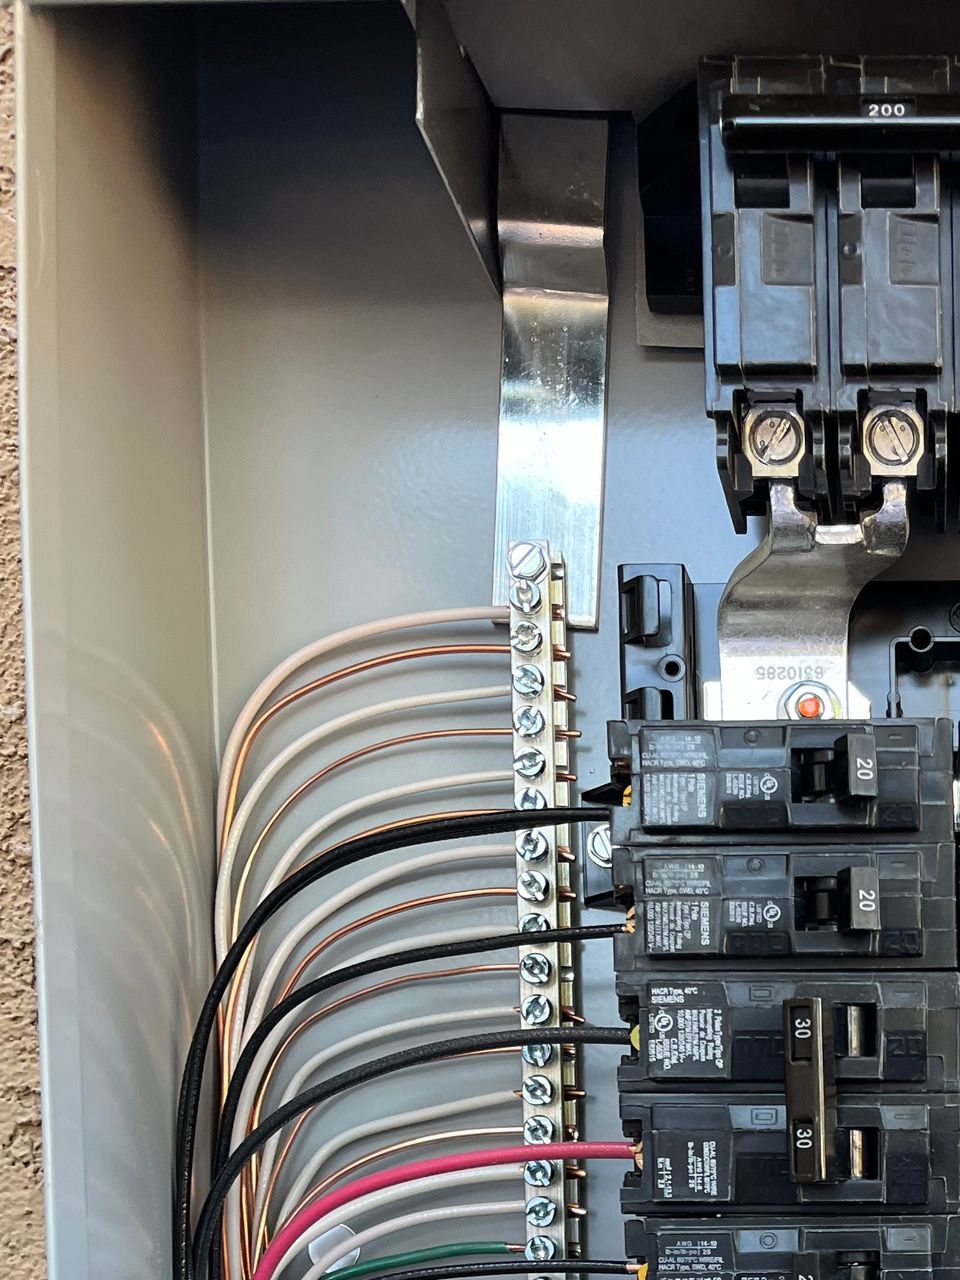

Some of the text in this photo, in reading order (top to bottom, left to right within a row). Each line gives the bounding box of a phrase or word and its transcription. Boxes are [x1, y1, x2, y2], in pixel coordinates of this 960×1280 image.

[868, 104, 905, 116] 200
[856, 757, 875, 781] 20
[697, 774, 706, 817] SIEMENS
[859, 890, 875, 911] 20
[700, 901, 709, 945] SIEMENS
[651, 995, 684, 1003] SIEMENS
[795, 1019, 811, 1038] 30
[797, 1129, 812, 1148] 30
